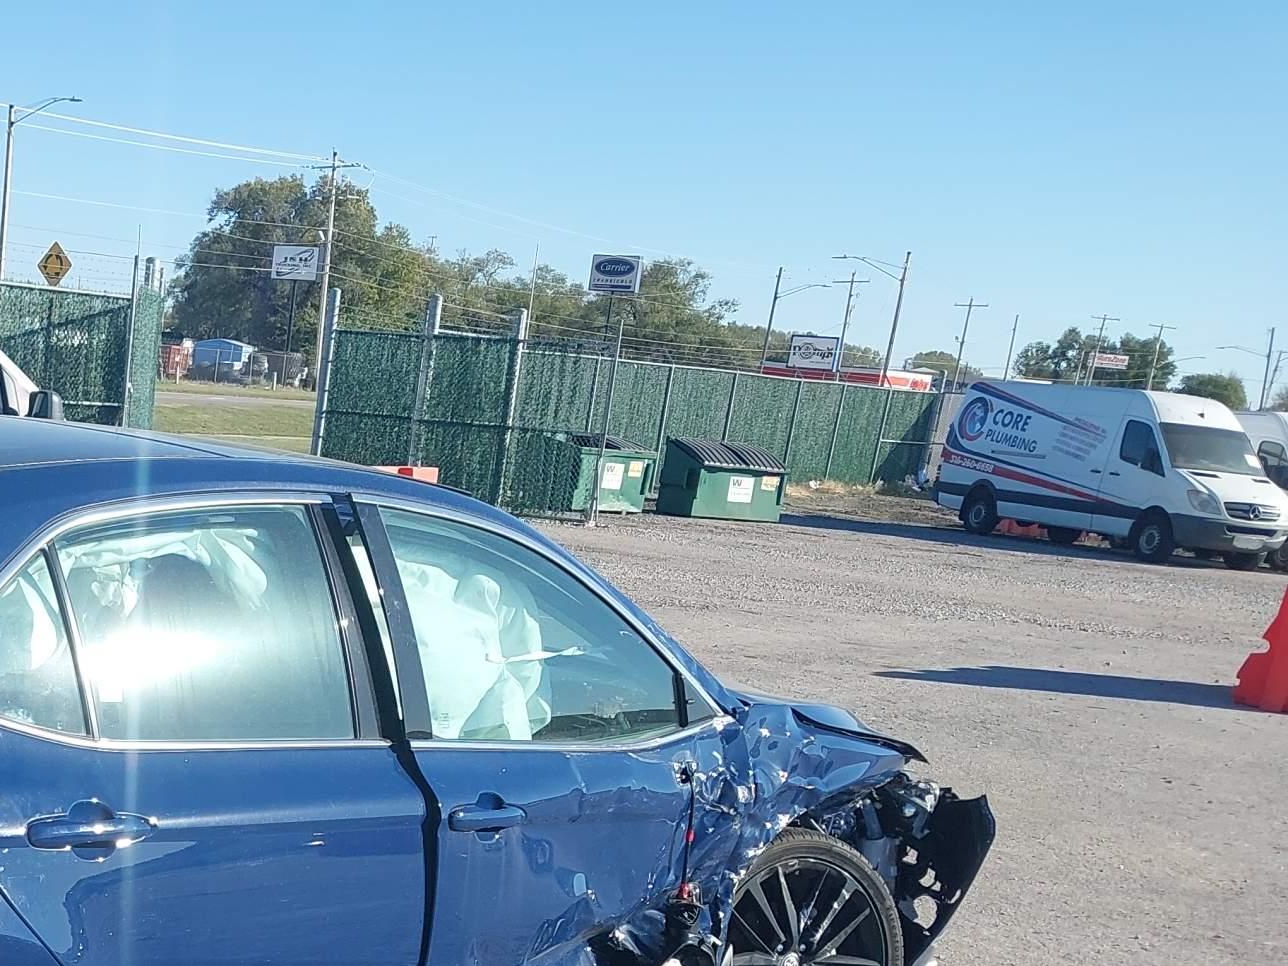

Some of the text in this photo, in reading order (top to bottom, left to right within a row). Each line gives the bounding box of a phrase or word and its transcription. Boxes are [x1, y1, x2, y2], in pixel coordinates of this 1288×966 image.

[600, 262, 630, 272] Carrier
[992, 409, 1032, 433] CORE
[984, 429, 1038, 453] PLUMBING
